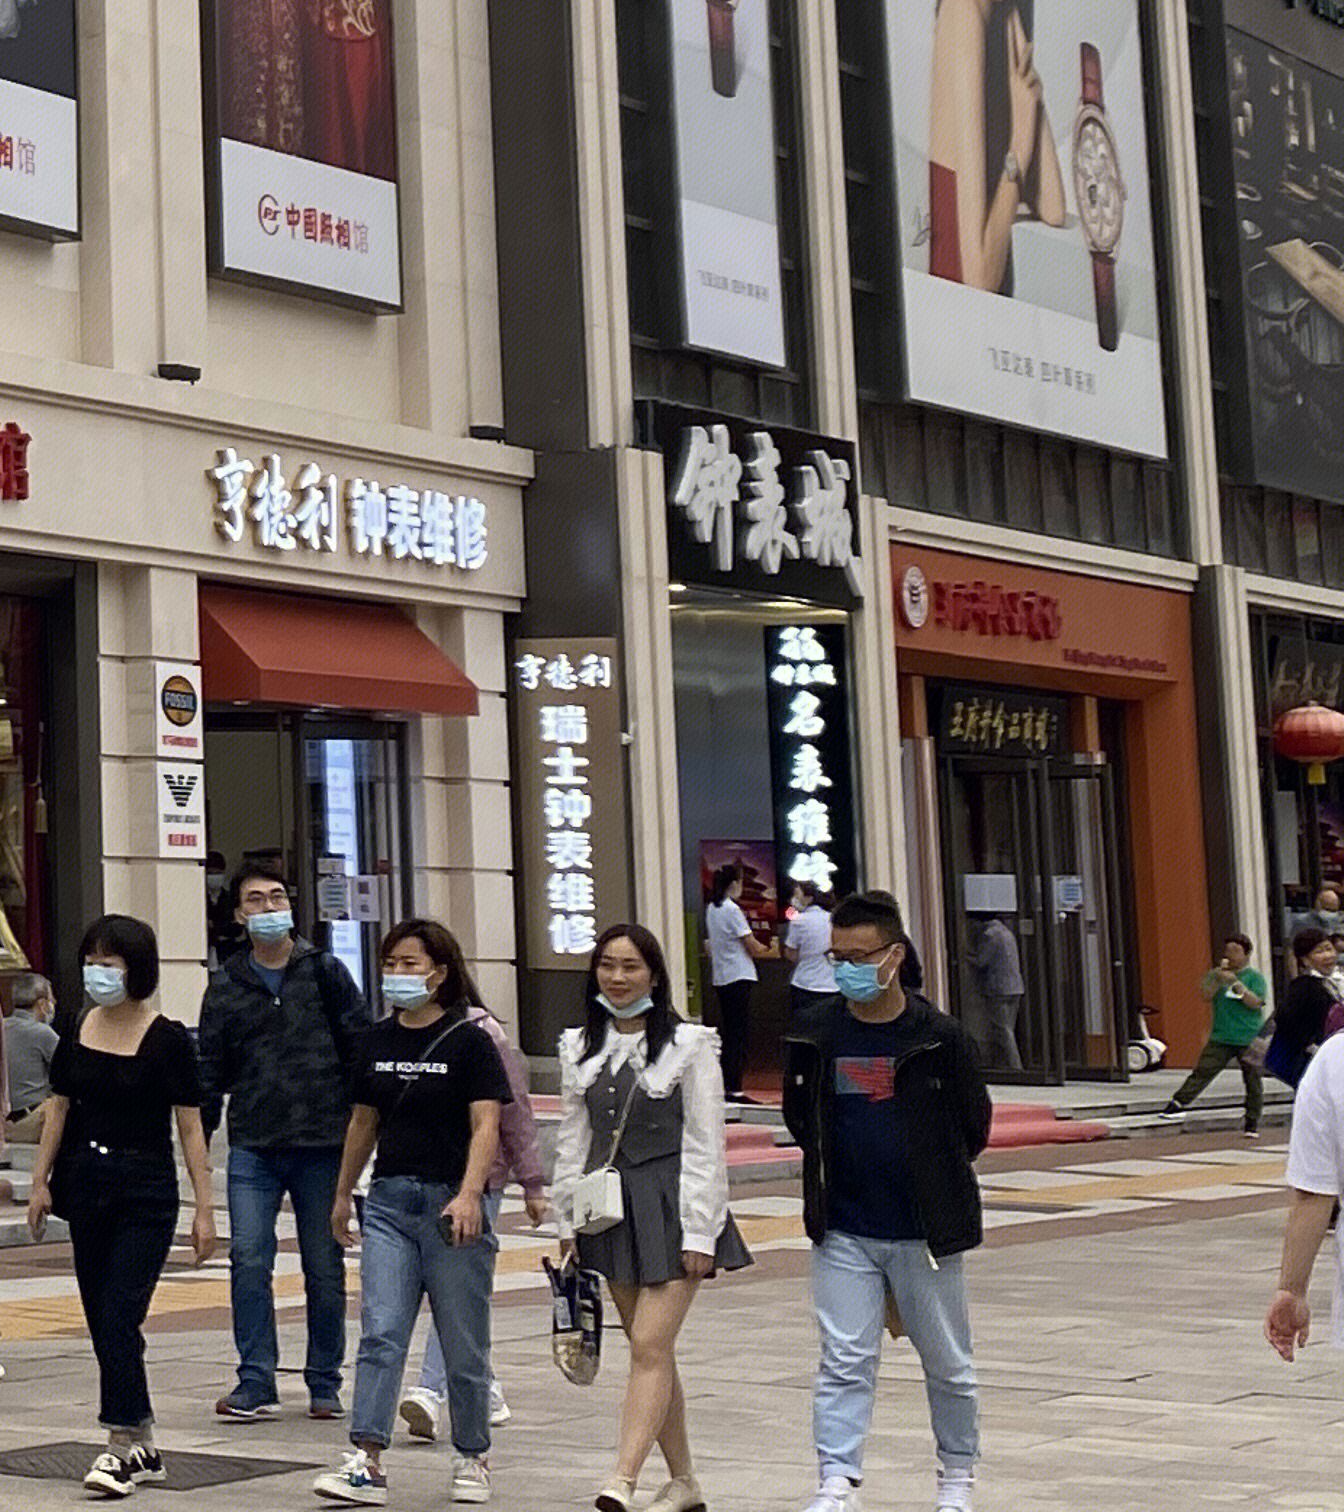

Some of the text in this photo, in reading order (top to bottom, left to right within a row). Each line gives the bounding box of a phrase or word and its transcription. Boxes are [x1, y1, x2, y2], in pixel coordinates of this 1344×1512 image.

[206, 448, 488, 569] 亨德利 钟表维修
[515, 654, 611, 690] 亨德利
[540, 705, 597, 954] 瑞士钟表维修
